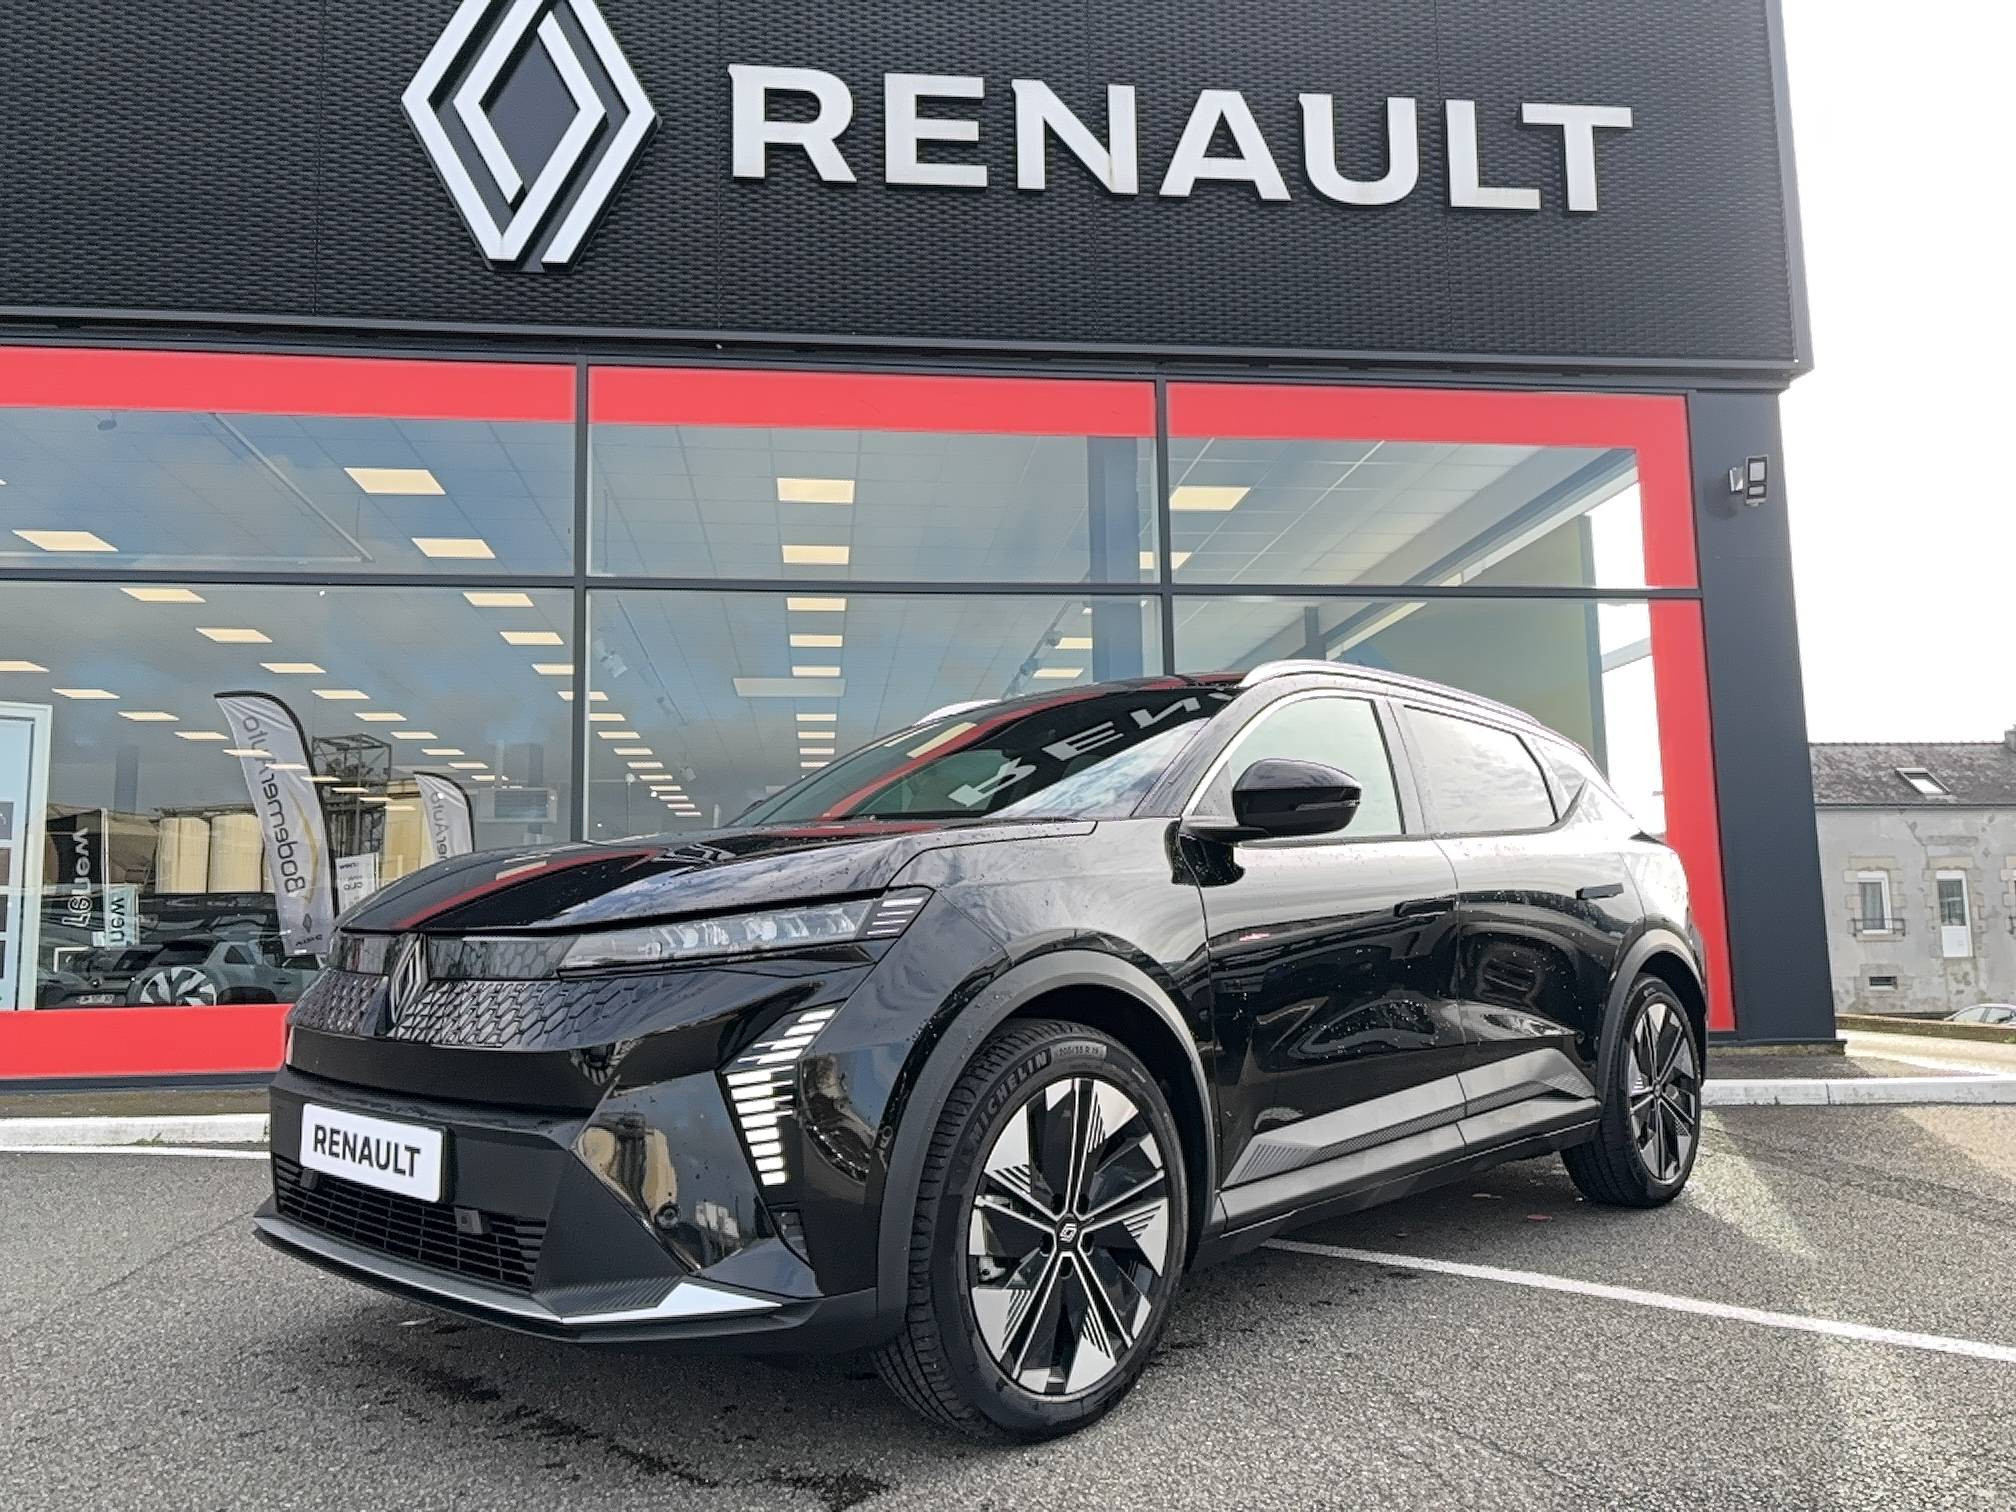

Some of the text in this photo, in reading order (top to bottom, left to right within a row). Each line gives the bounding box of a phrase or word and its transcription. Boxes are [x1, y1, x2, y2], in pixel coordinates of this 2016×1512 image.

[727, 62, 1634, 213] RENAULT
[968, 1050, 1049, 1146] MICHELIN
[313, 1124, 422, 1178] RENAULT
